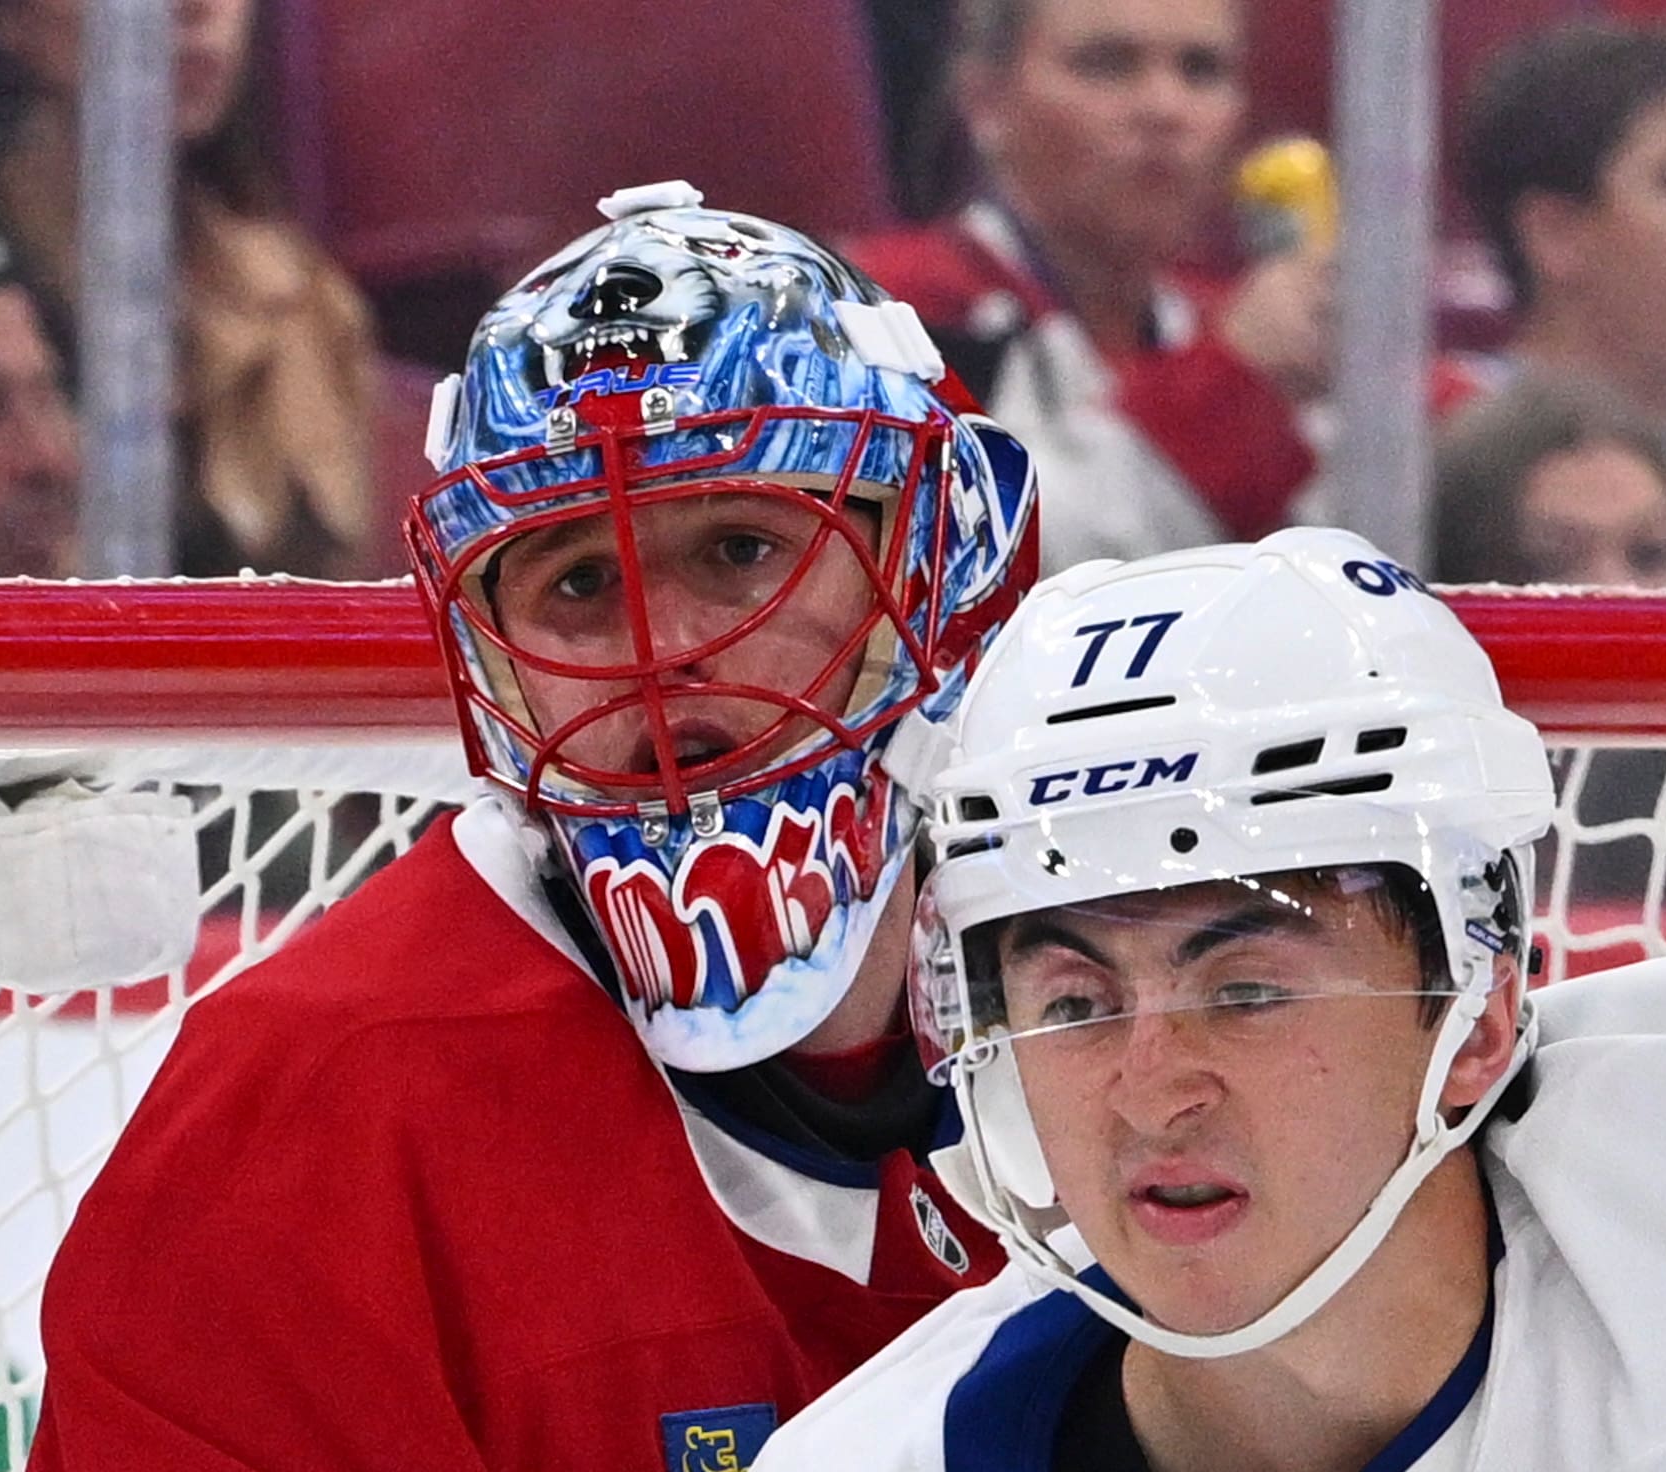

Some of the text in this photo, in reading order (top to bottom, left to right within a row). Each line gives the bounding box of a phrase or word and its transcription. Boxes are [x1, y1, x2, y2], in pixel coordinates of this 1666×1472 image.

[534, 364, 703, 409] TRUE
[1070, 611, 1184, 689] 77
[1028, 752, 1200, 806] CCM
